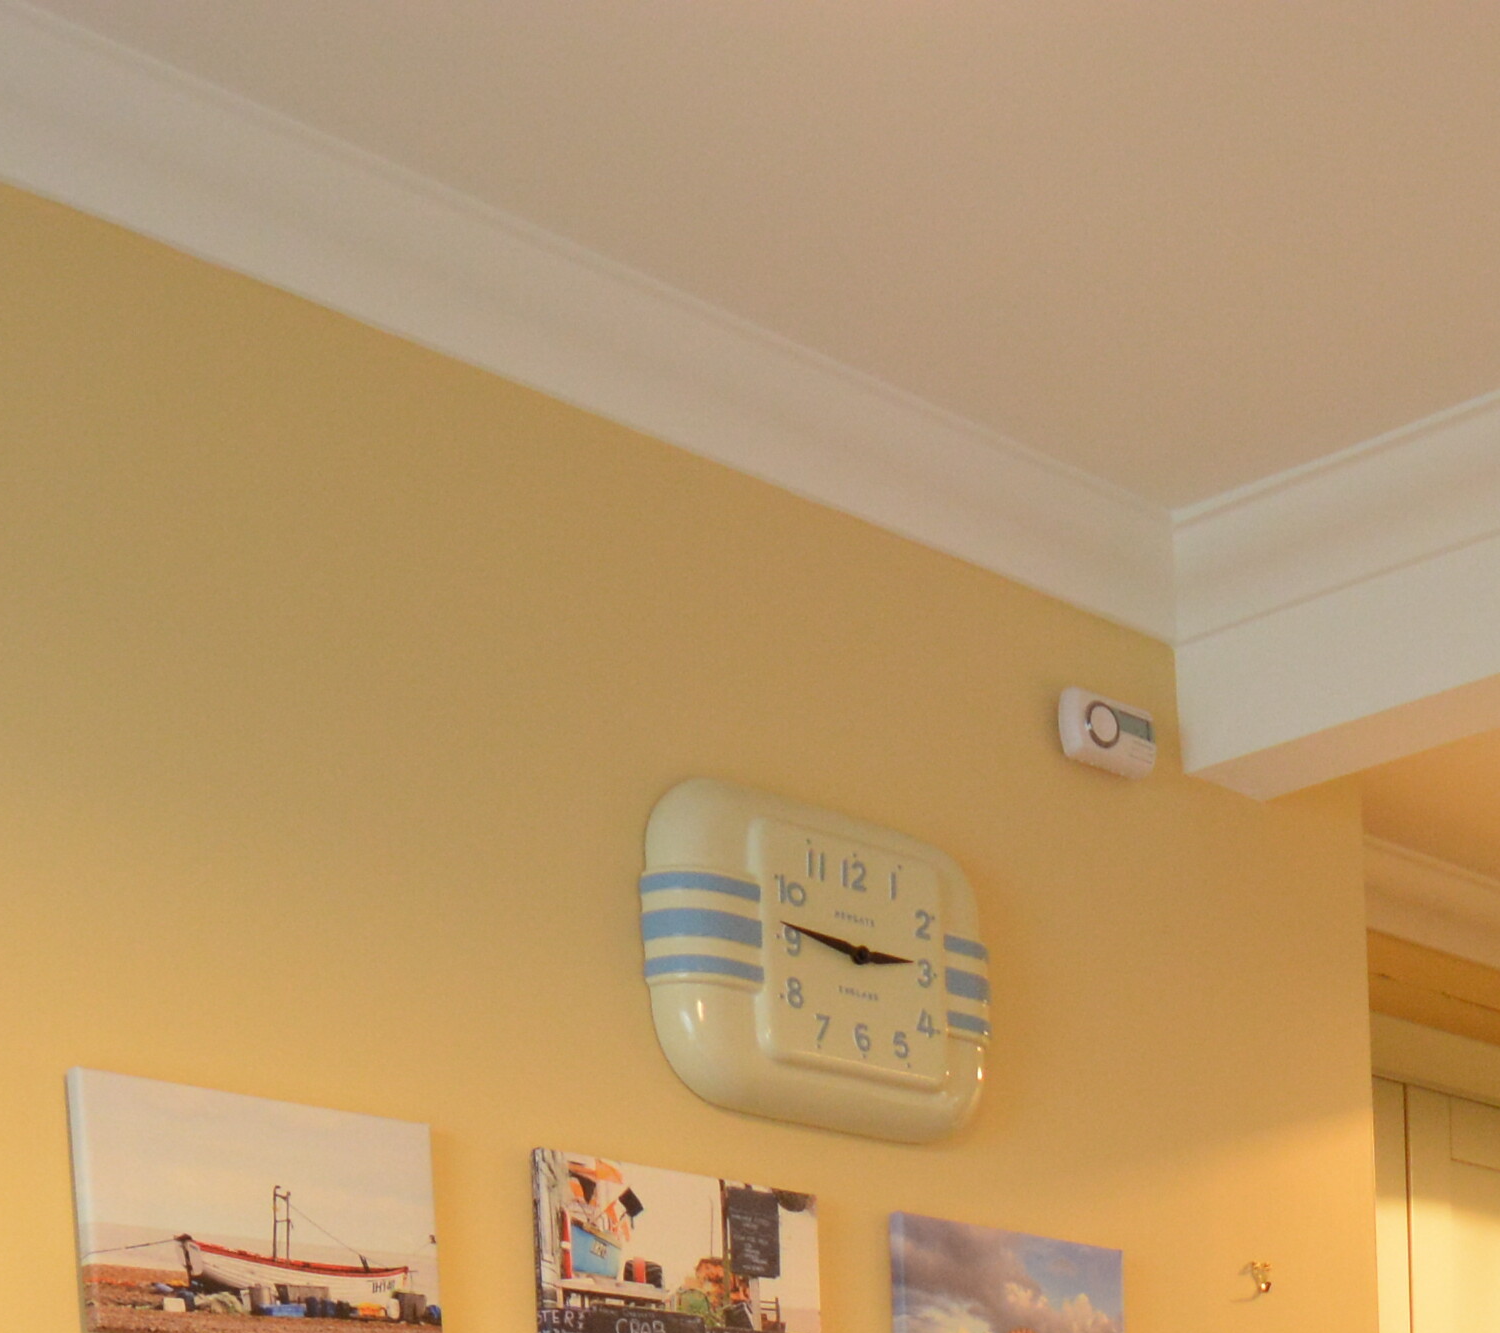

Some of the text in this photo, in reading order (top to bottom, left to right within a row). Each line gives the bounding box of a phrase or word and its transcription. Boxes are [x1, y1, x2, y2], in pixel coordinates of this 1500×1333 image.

[807, 848, 826, 882] 11
[841, 858, 868, 893] 12
[779, 873, 807, 907] 10
[889, 871, 898, 901] 1
[783, 924, 803, 957] 9
[914, 908, 932, 941] 2
[916, 958, 933, 989] 3
[786, 976, 805, 1010] 8
[815, 1012, 832, 1041] 7
[853, 1022, 872, 1052] 6
[916, 1008, 935, 1039] 4
[892, 1030, 910, 1059] 5
